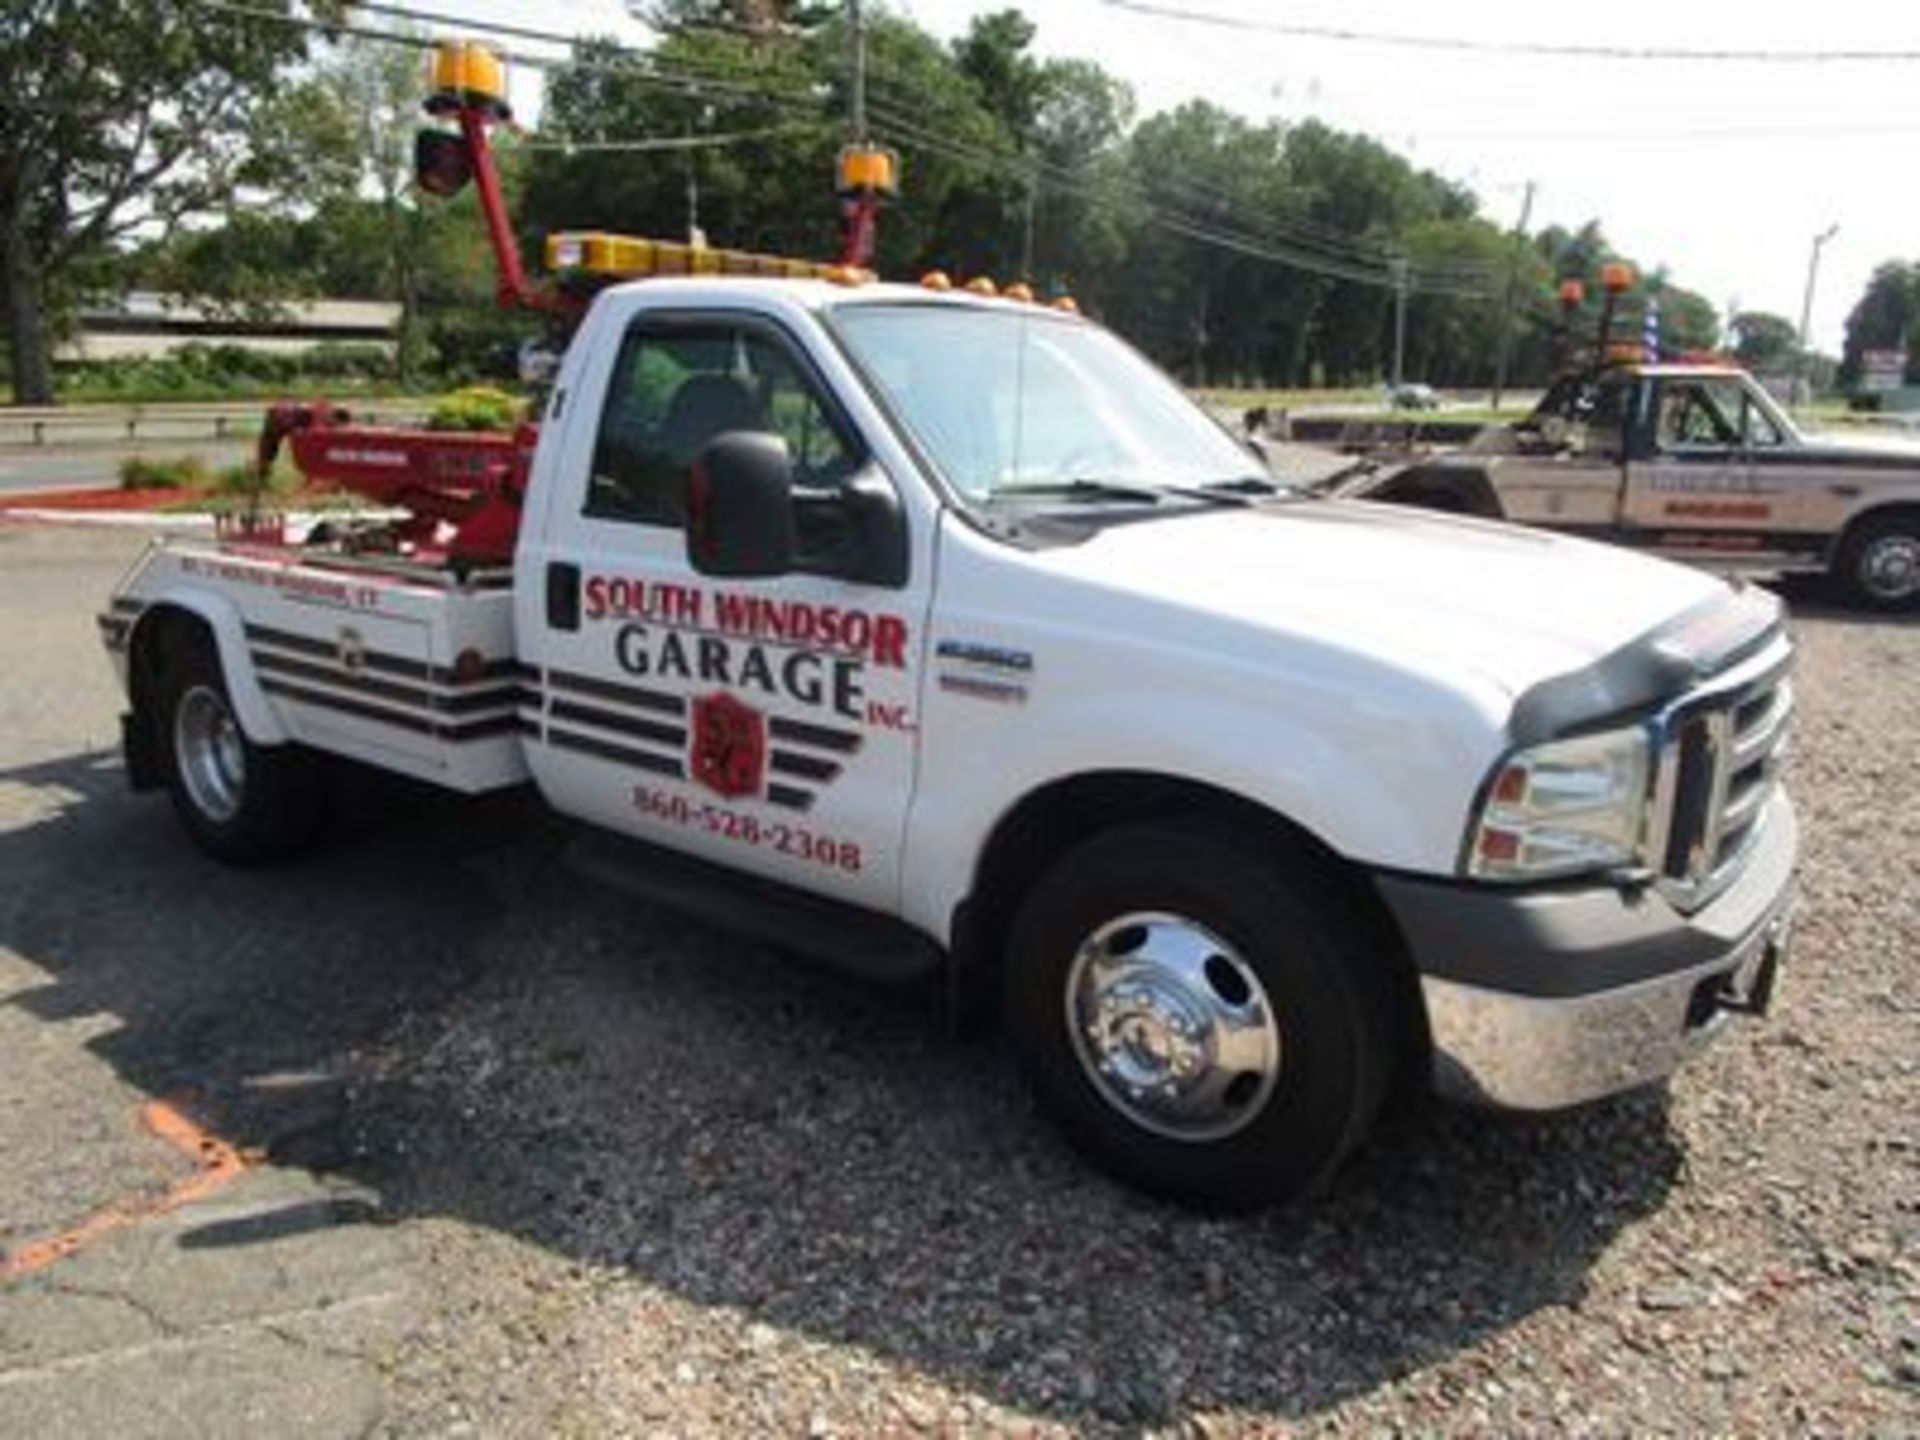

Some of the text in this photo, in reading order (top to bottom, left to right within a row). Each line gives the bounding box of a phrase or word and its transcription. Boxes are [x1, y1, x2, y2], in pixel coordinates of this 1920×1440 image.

[585, 577, 702, 621] SOUTH
[715, 591, 907, 669] WINDSOR
[615, 622, 864, 721] GARAGE
